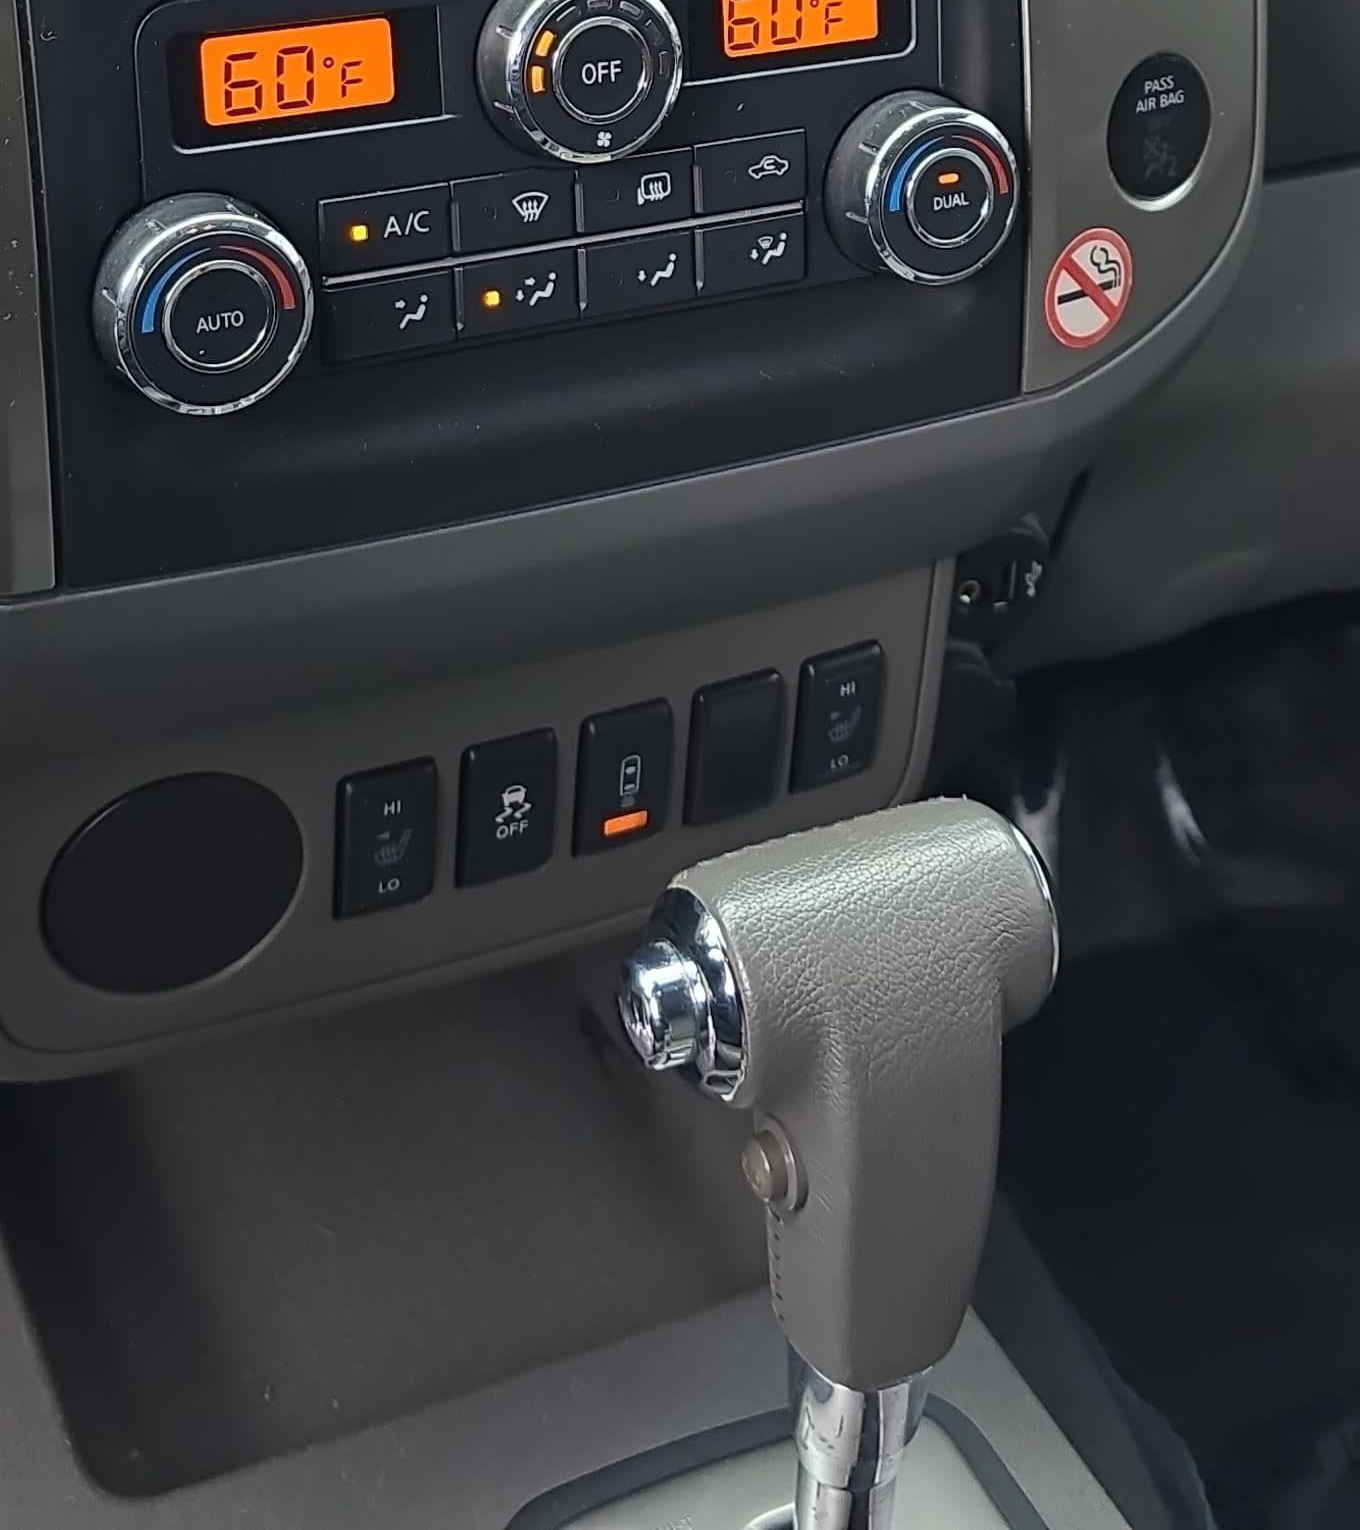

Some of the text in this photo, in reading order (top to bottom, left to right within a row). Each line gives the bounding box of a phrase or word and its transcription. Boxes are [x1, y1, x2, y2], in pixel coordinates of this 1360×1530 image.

[581, 60, 622, 84] OFF
[1144, 75, 1175, 94] PASS
[1135, 89, 1185, 113] AIR BAG
[932, 192, 970, 211] DUAL
[383, 210, 430, 239] A/C
[195, 310, 245, 334] AUTO
[840, 681, 856, 697] HI
[383, 800, 402, 816] HI
[495, 819, 529, 840] OFF
[377, 877, 401, 894] LO
